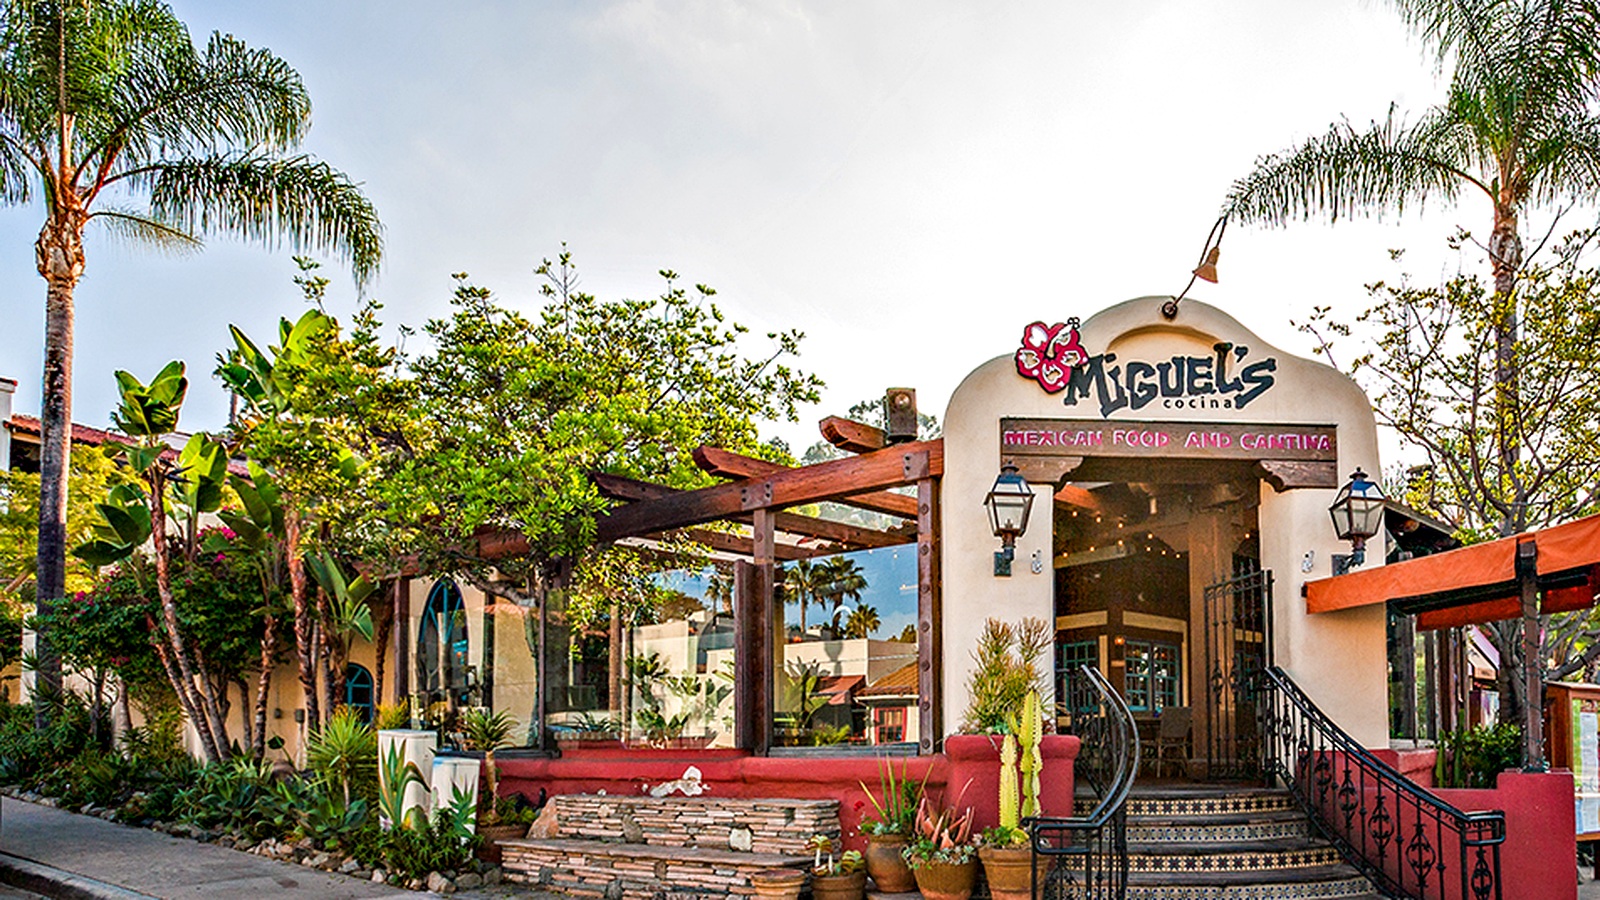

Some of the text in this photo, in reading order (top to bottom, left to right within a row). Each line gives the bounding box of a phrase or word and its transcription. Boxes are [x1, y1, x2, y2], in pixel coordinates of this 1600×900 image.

[1163, 397, 1232, 409] cocina
[1003, 430, 1331, 450] MEXICAN FOOD AND CANTINA
